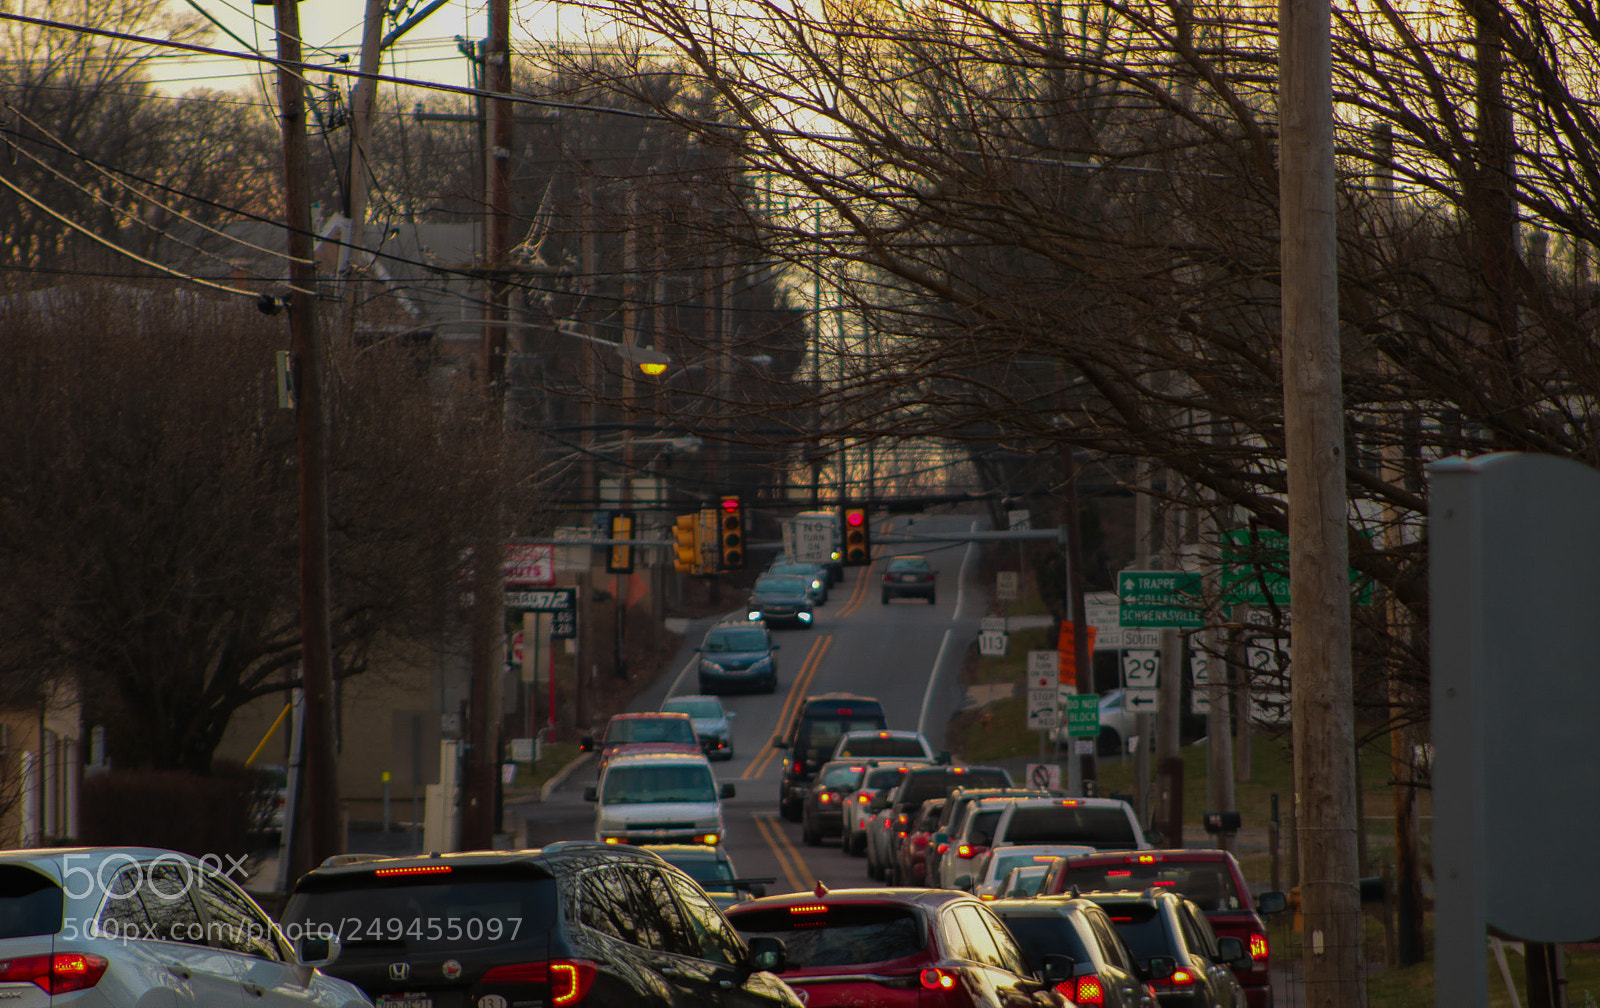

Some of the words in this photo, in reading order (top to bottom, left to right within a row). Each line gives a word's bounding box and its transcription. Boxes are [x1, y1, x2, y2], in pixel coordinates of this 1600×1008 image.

[804, 522, 823, 532] NO
[1138, 578, 1176, 590] TRAPPE
[1122, 609, 1201, 622] SCHWENKSVILLE
[983, 636, 1004, 650] 113
[1125, 633, 1158, 646] SOUTH
[1036, 653, 1049, 661] NO
[1128, 659, 1156, 679] 29
[1032, 693, 1055, 701] STOP
[1068, 699, 1079, 710] DO
[1082, 698, 1098, 709] NOT
[1038, 717, 1055, 726] RED
[1069, 711, 1097, 722] BLOCK
